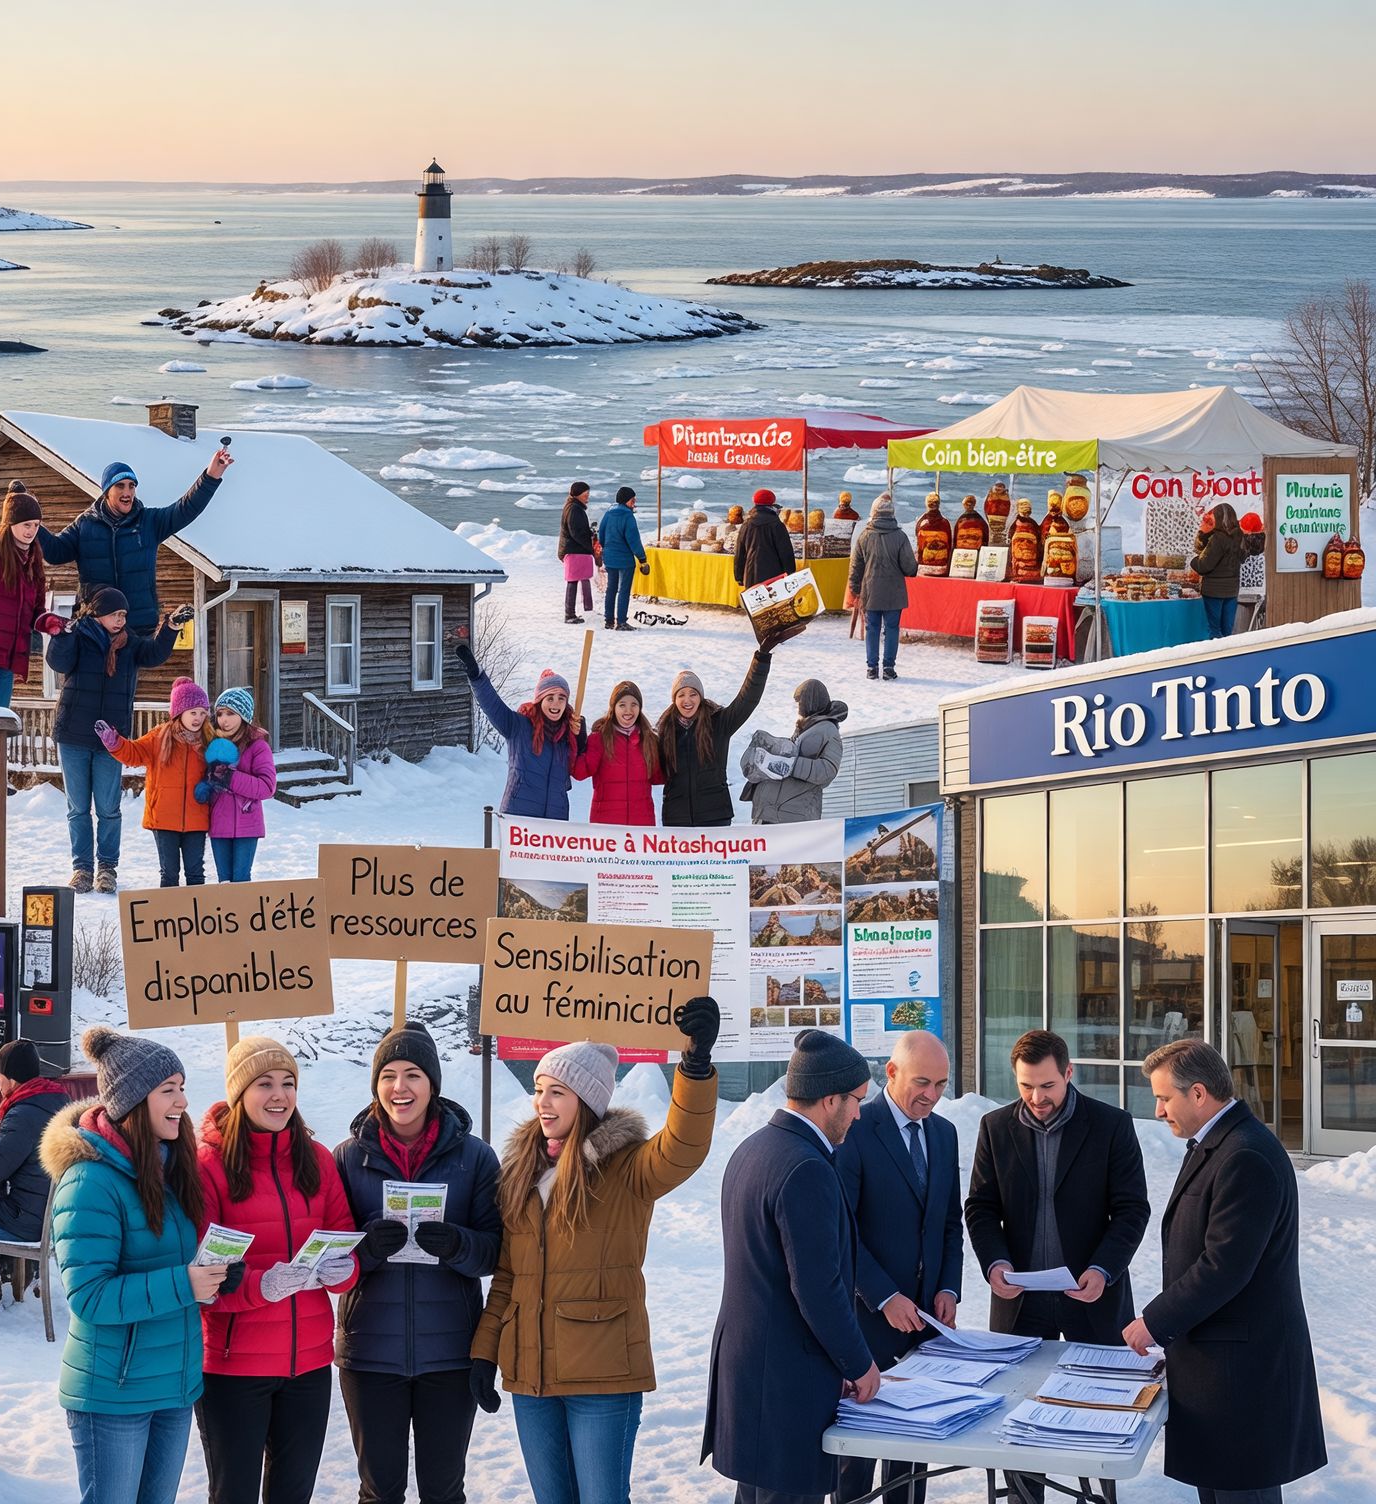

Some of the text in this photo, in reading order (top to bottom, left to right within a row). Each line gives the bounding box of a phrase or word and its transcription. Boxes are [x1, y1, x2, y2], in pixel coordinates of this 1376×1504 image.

[921, 441, 1057, 468] Coin bien-être
[1050, 666, 1326, 758] Rio Tinto
[509, 825, 617, 853] Bienvenue
[624, 833, 636, 853] à
[643, 833, 767, 860] Natashquan
[351, 856, 464, 897] Plus de
[130, 892, 316, 952] Emplois d'été
[330, 914, 477, 939] ressources
[494, 931, 700, 980] Sensibilisation
[495, 992, 529, 1014] au
